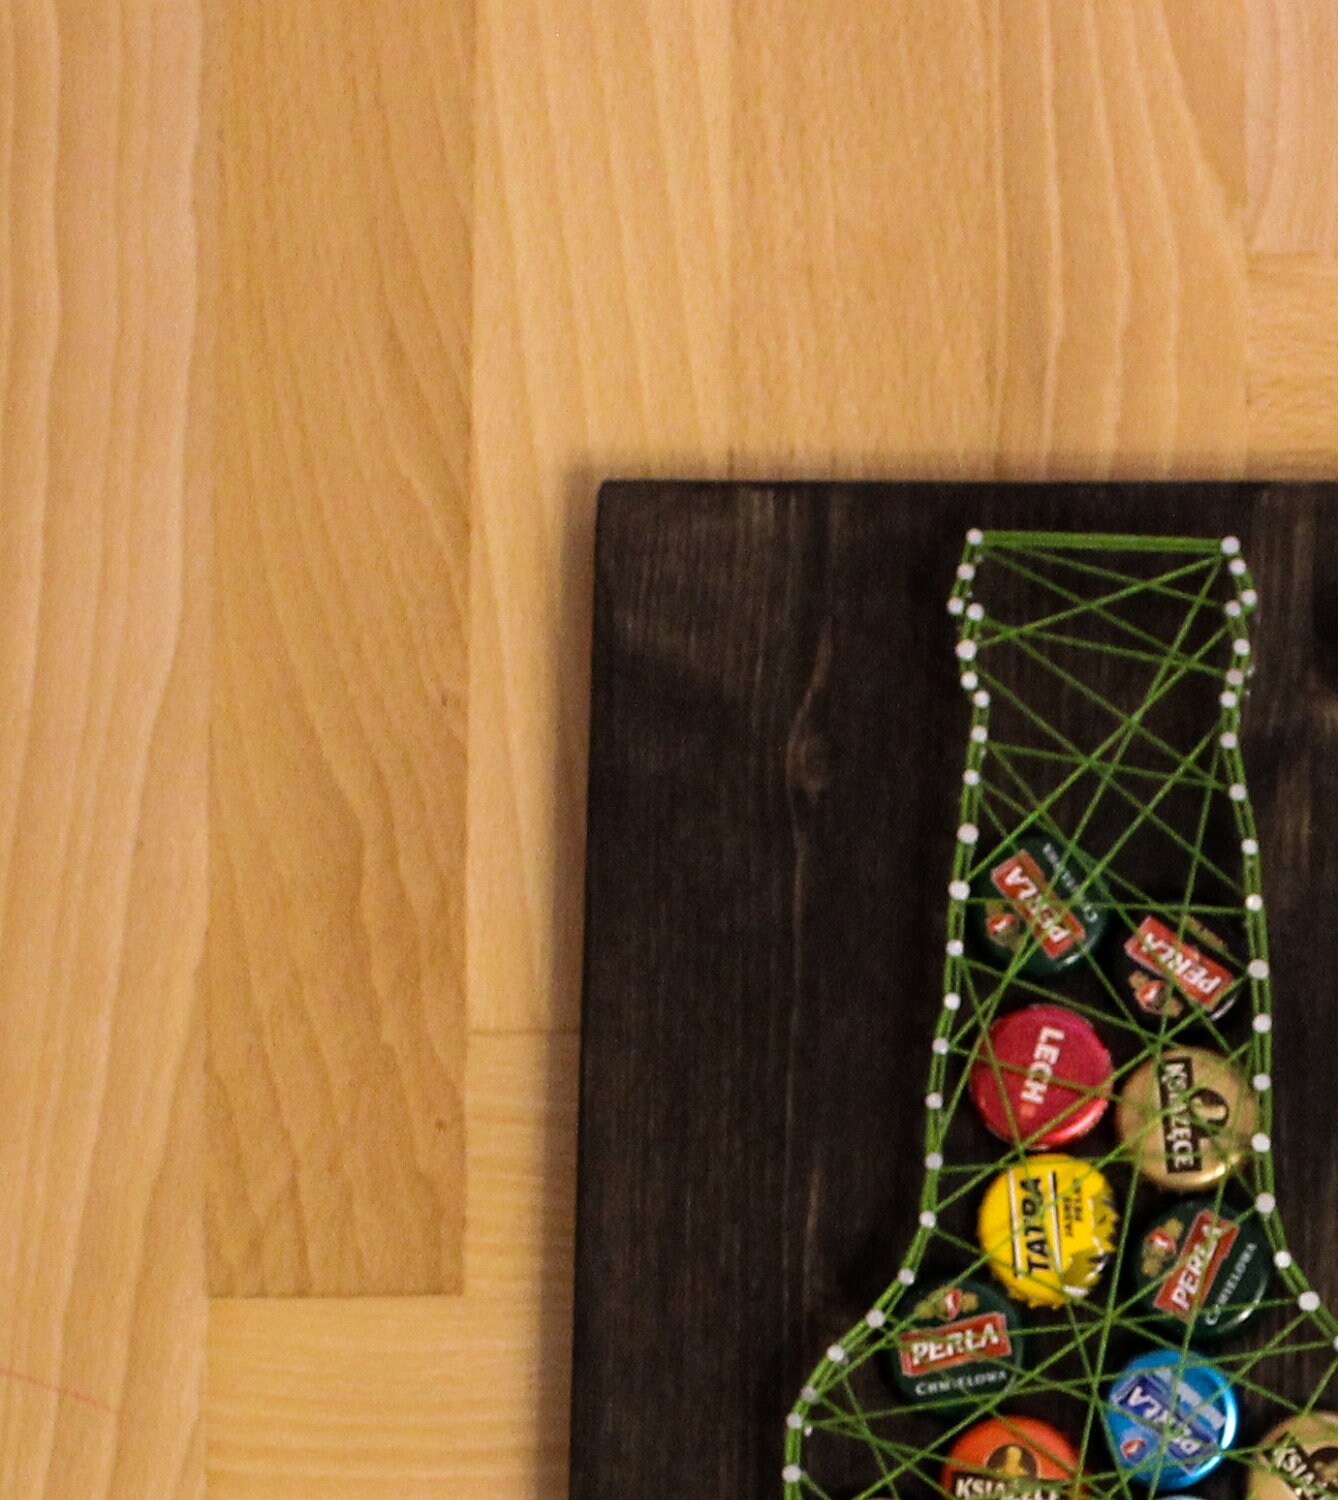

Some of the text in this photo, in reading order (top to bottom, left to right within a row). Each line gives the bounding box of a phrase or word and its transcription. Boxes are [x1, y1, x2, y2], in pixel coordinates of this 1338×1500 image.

[1019, 1027, 1066, 1104] LECH
[1019, 1177, 1049, 1272] TATRA
[911, 1323, 1000, 1365] PERŁA
